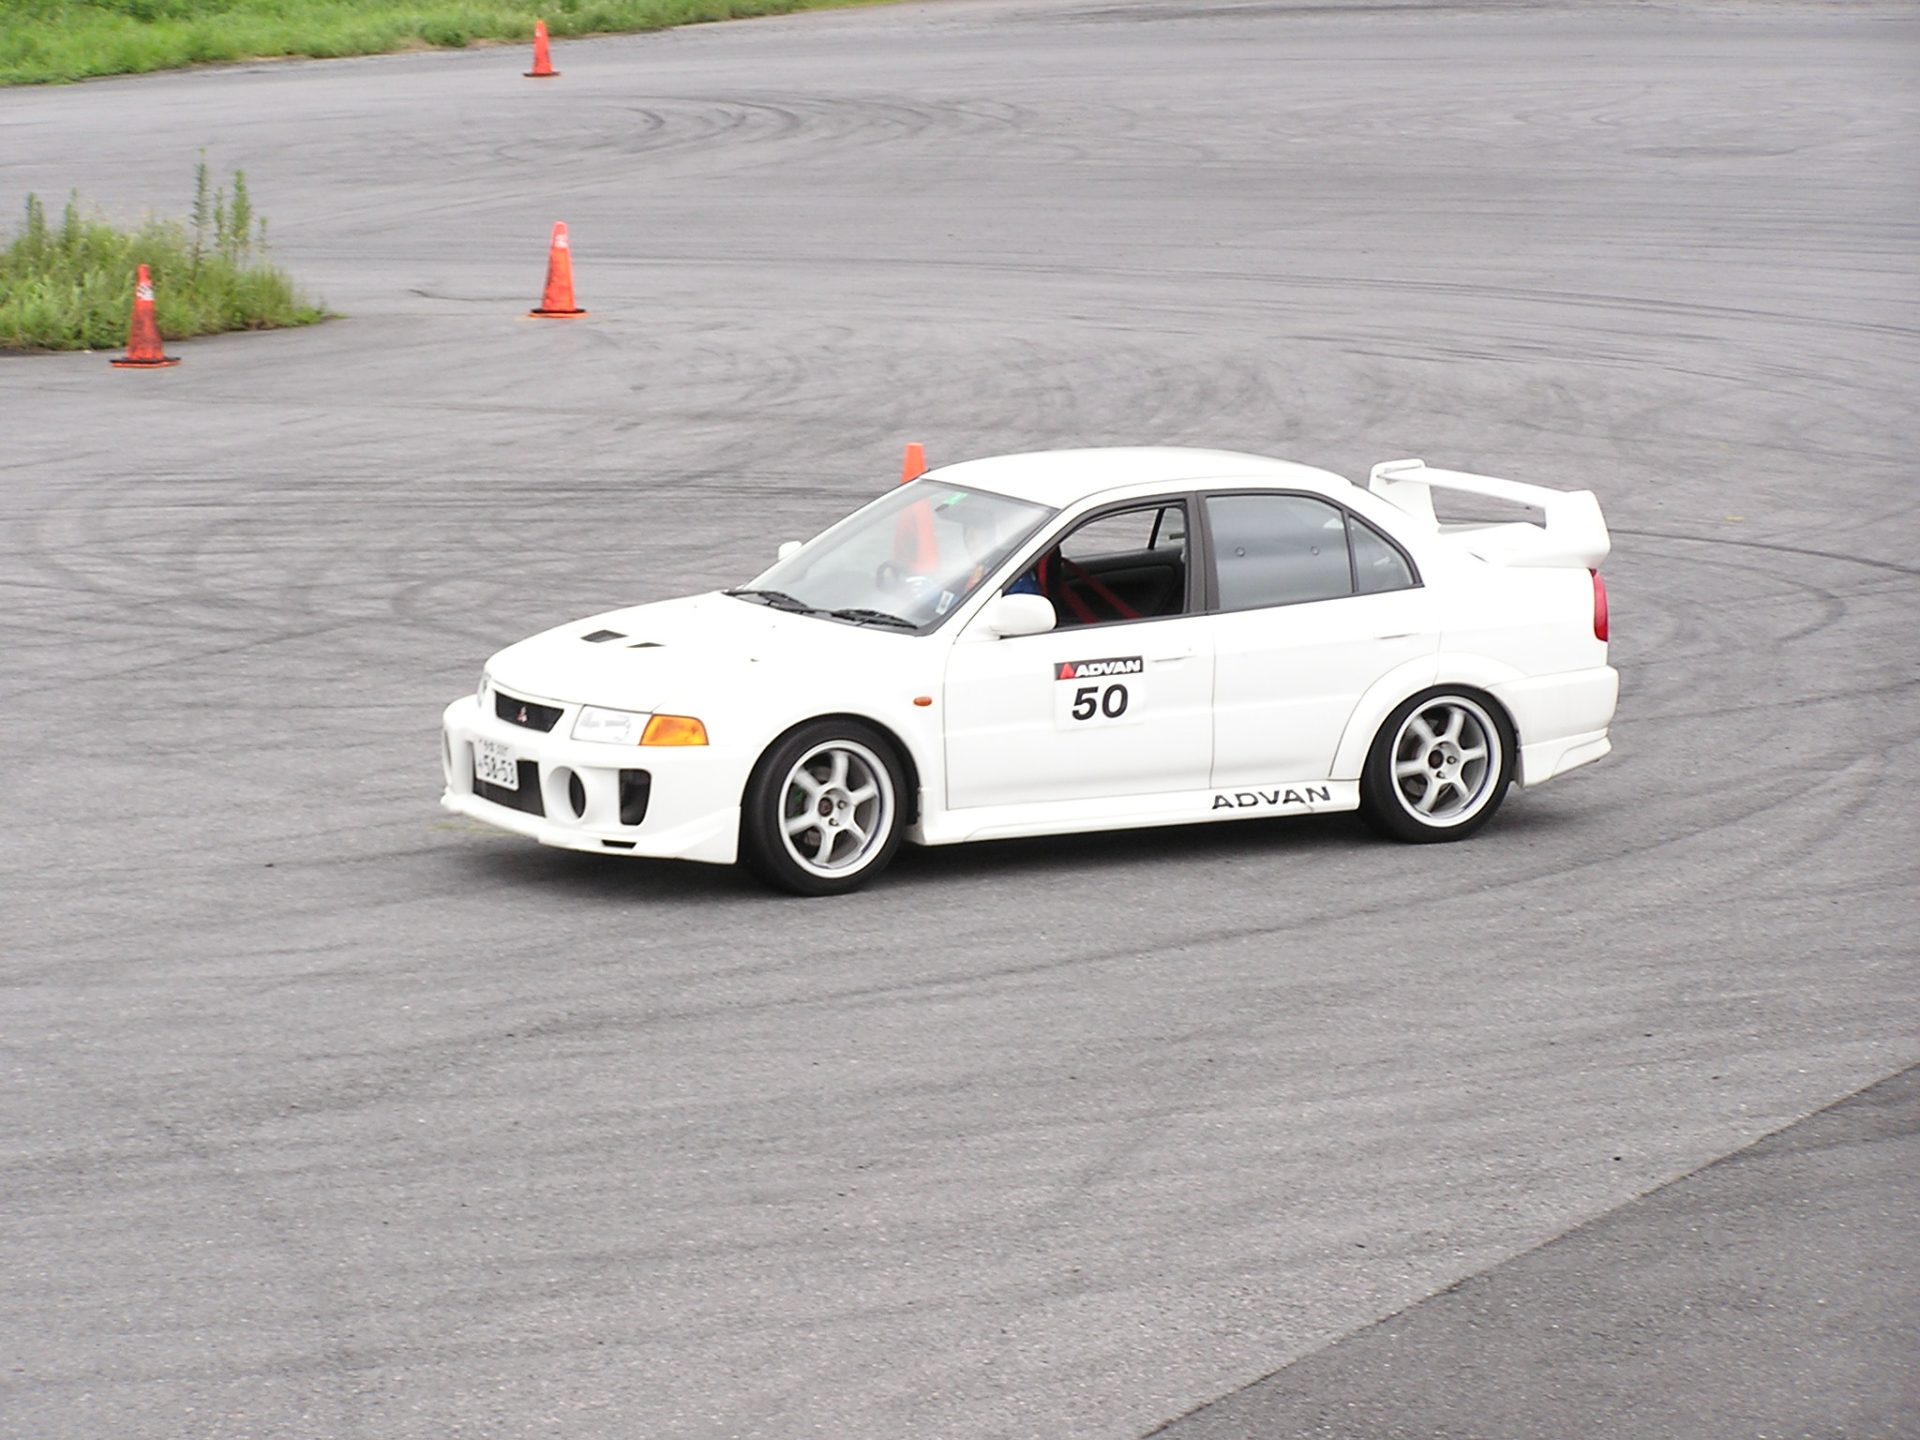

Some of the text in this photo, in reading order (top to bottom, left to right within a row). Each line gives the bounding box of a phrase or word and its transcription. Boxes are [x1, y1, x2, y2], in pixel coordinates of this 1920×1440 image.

[1074, 659, 1141, 678] ADVAN
[1072, 684, 1128, 720] 50
[1212, 786, 1331, 810] ADVAN
